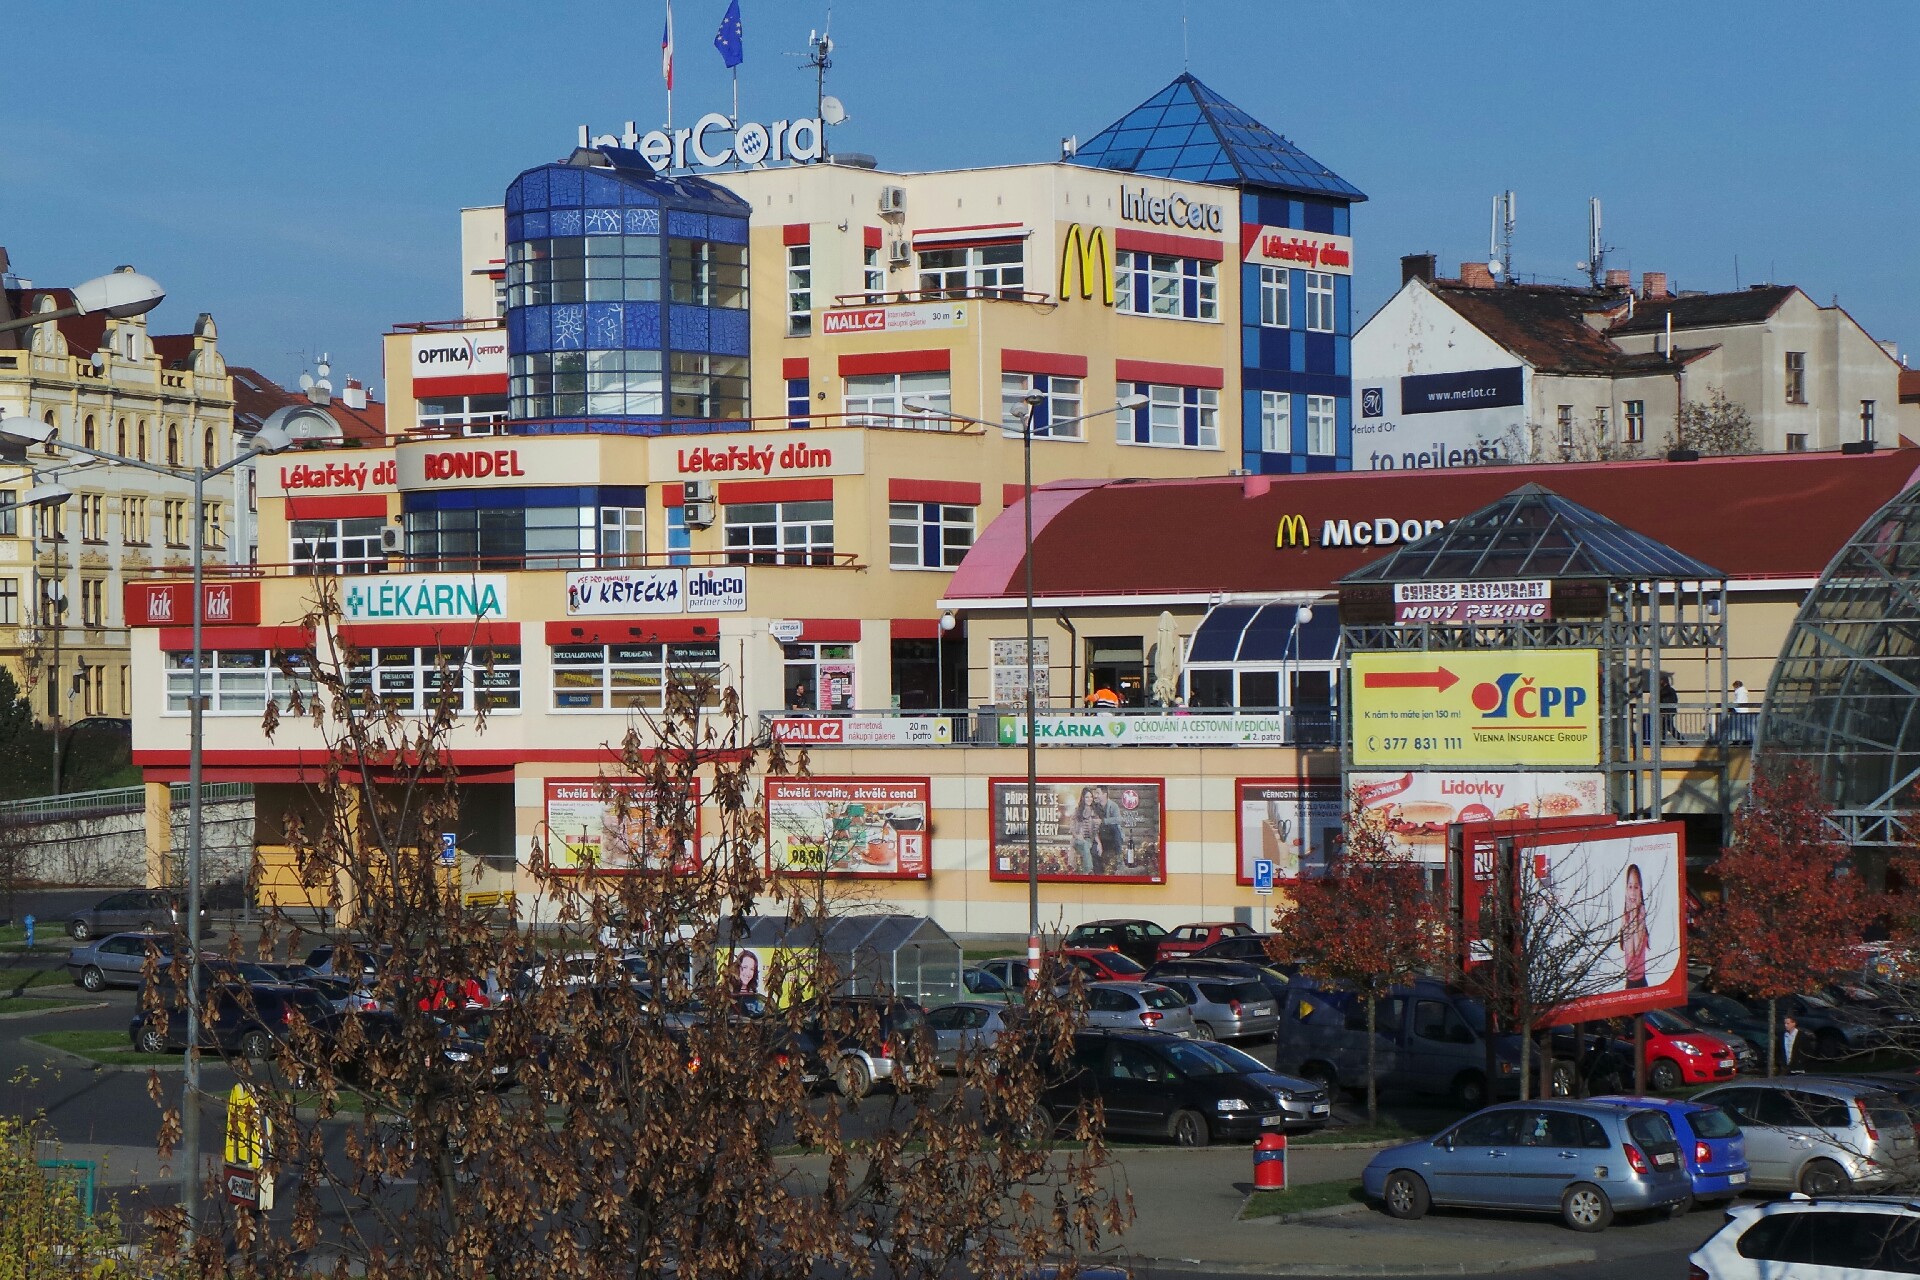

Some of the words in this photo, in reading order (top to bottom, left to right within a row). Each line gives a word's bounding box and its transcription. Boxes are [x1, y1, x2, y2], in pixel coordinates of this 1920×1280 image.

[578, 112, 822, 172] InterCora
[1121, 184, 1223, 233] InterCora
[1262, 234, 1319, 268] Lékařský
[1319, 242, 1350, 268] dům
[826, 312, 884, 331] MALL.CZ
[932, 312, 943, 321] 30
[418, 347, 469, 364] OPTIKA
[1428, 387, 1497, 401] www.merlot.cz
[424, 449, 525, 481] RONDEL
[678, 444, 775, 476] Lékařský
[779, 442, 832, 469] dům
[1370, 450, 1395, 470] to
[280, 462, 368, 491] Lékařský
[372, 460, 397, 486] dů
[580, 584, 592, 604] U
[599, 574, 679, 604] KRTEČKA
[689, 570, 743, 597] chicco
[1460, 581, 1545, 599] RESTAURANT
[149, 587, 172, 616] kik
[207, 586, 230, 615] kik
[366, 578, 502, 617] LÉKÁRNA
[689, 597, 721, 609] partner
[722, 595, 744, 608] shop
[1401, 602, 1457, 619] NOVÝ
[1466, 603, 1546, 619] PEKING
[1513, 677, 1587, 718] ČPP
[1364, 711, 1371, 719] K
[1371, 709, 1389, 719] nám
[1390, 710, 1399, 719] to
[1400, 709, 1420, 719] máte
[1421, 710, 1434, 720] jen
[1435, 709, 1449, 719] 150
[1450, 710, 1461, 719] m!
[776, 722, 840, 740] MALL.CZ
[848, 720, 883, 730] internetová
[909, 722, 920, 731] 20
[920, 723, 928, 731] m
[1022, 719, 1105, 737] LÉKÁRNA
[1133, 717, 1180, 732] OČKOVÁNÍ
[1181, 720, 1188, 732] A
[1189, 717, 1234, 732] CESTOVNÍ
[1234, 717, 1281, 732] MEDICÍNA
[848, 731, 874, 741] nákupní
[874, 731, 896, 742] galerie
[912, 731, 932, 741] patro
[1252, 733, 1260, 741] 2.
[1261, 733, 1281, 743] patro
[1383, 737, 1407, 749] 377
[1414, 737, 1438, 749] 831
[1444, 737, 1462, 749] 111
[1473, 732, 1505, 742] VIENNA
[1507, 732, 1556, 742] INSURANCE
[1557, 732, 1588, 742] GROUP
[557, 788, 589, 799] Skvělá
[777, 787, 811, 798] Skvělá
[814, 787, 850, 799] kvalita,
[854, 788, 887, 798] skvělá
[889, 788, 917, 799] cena!
[1262, 790, 1297, 798] VĚRNOSTN
[1441, 779, 1505, 798] Lidovky
[1049, 793, 1059, 804] SE
[1005, 807, 1020, 821] NA
[1005, 822, 1028, 835] ZIMNÍ
[1035, 822, 1059, 835] EČERY
[1257, 863, 1269, 880] P
